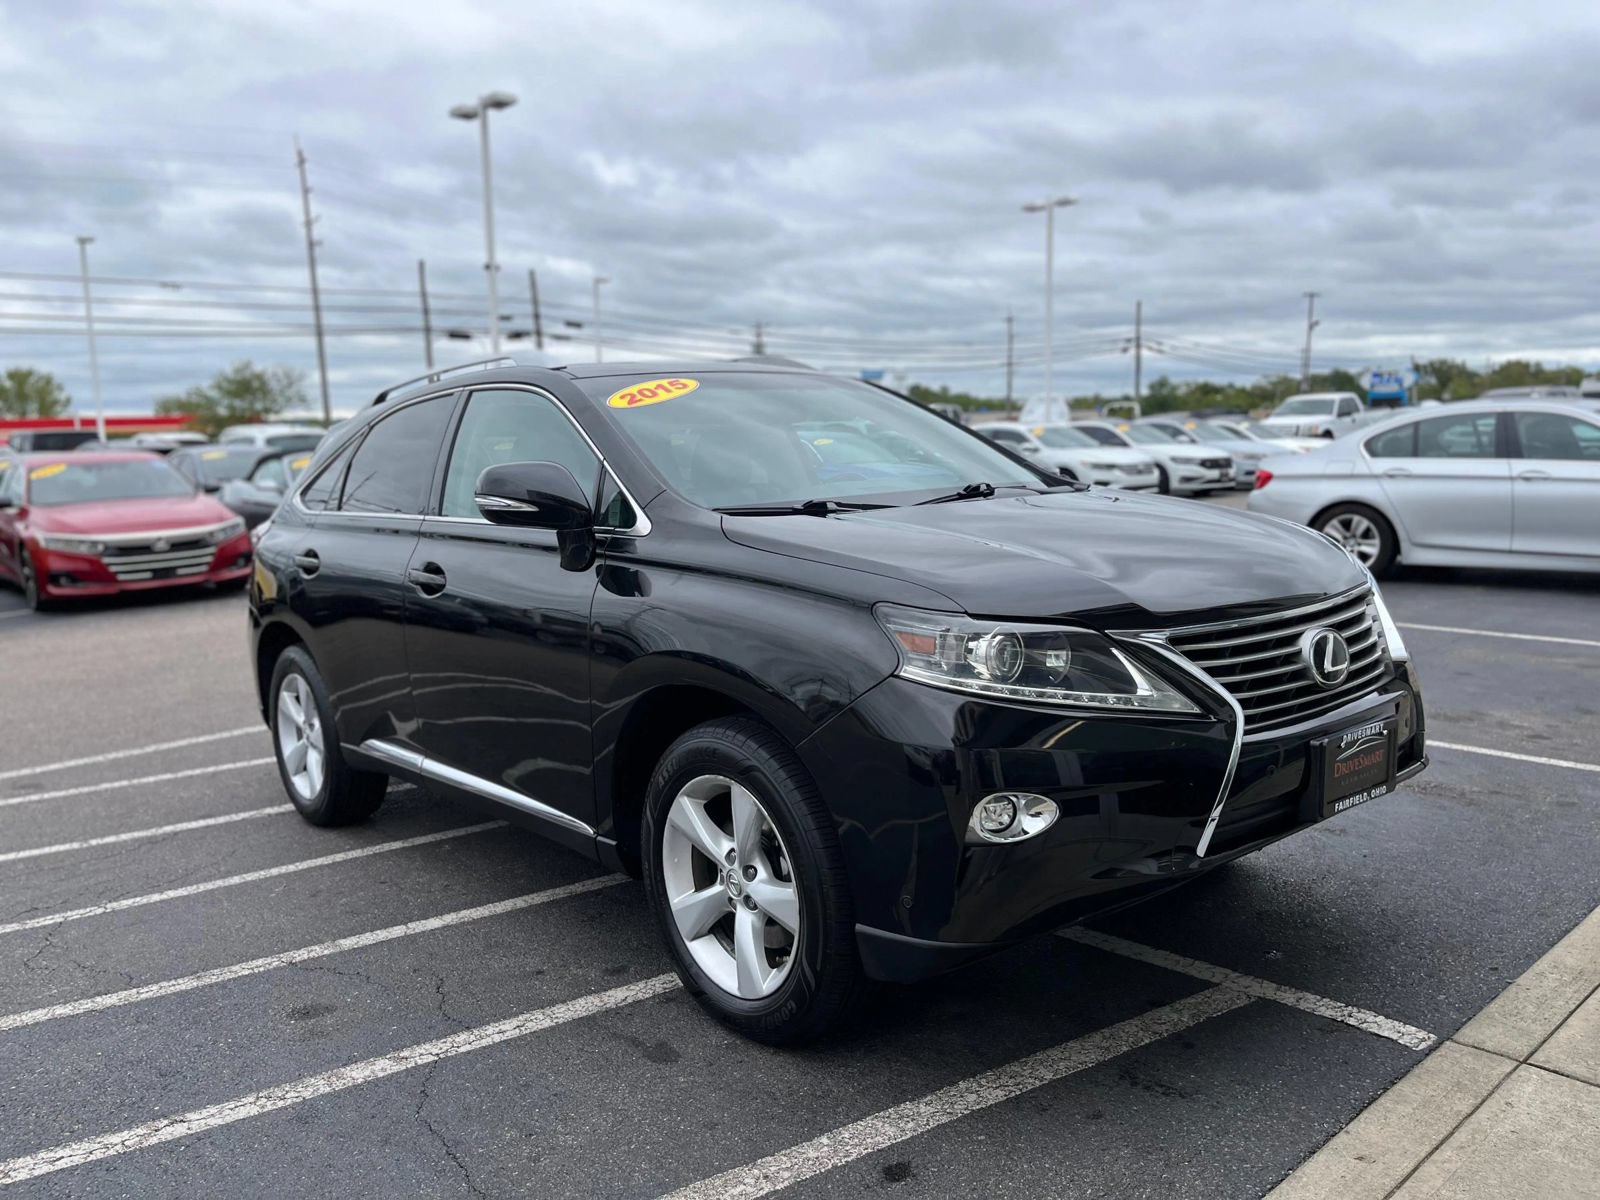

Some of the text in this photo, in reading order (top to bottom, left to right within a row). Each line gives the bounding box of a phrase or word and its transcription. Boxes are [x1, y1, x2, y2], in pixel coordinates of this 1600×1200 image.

[619, 380, 690, 406] 2015
[1342, 723, 1385, 743] DRIVESMART
[1334, 785, 1387, 813] FAIRFIELD, OHIO
